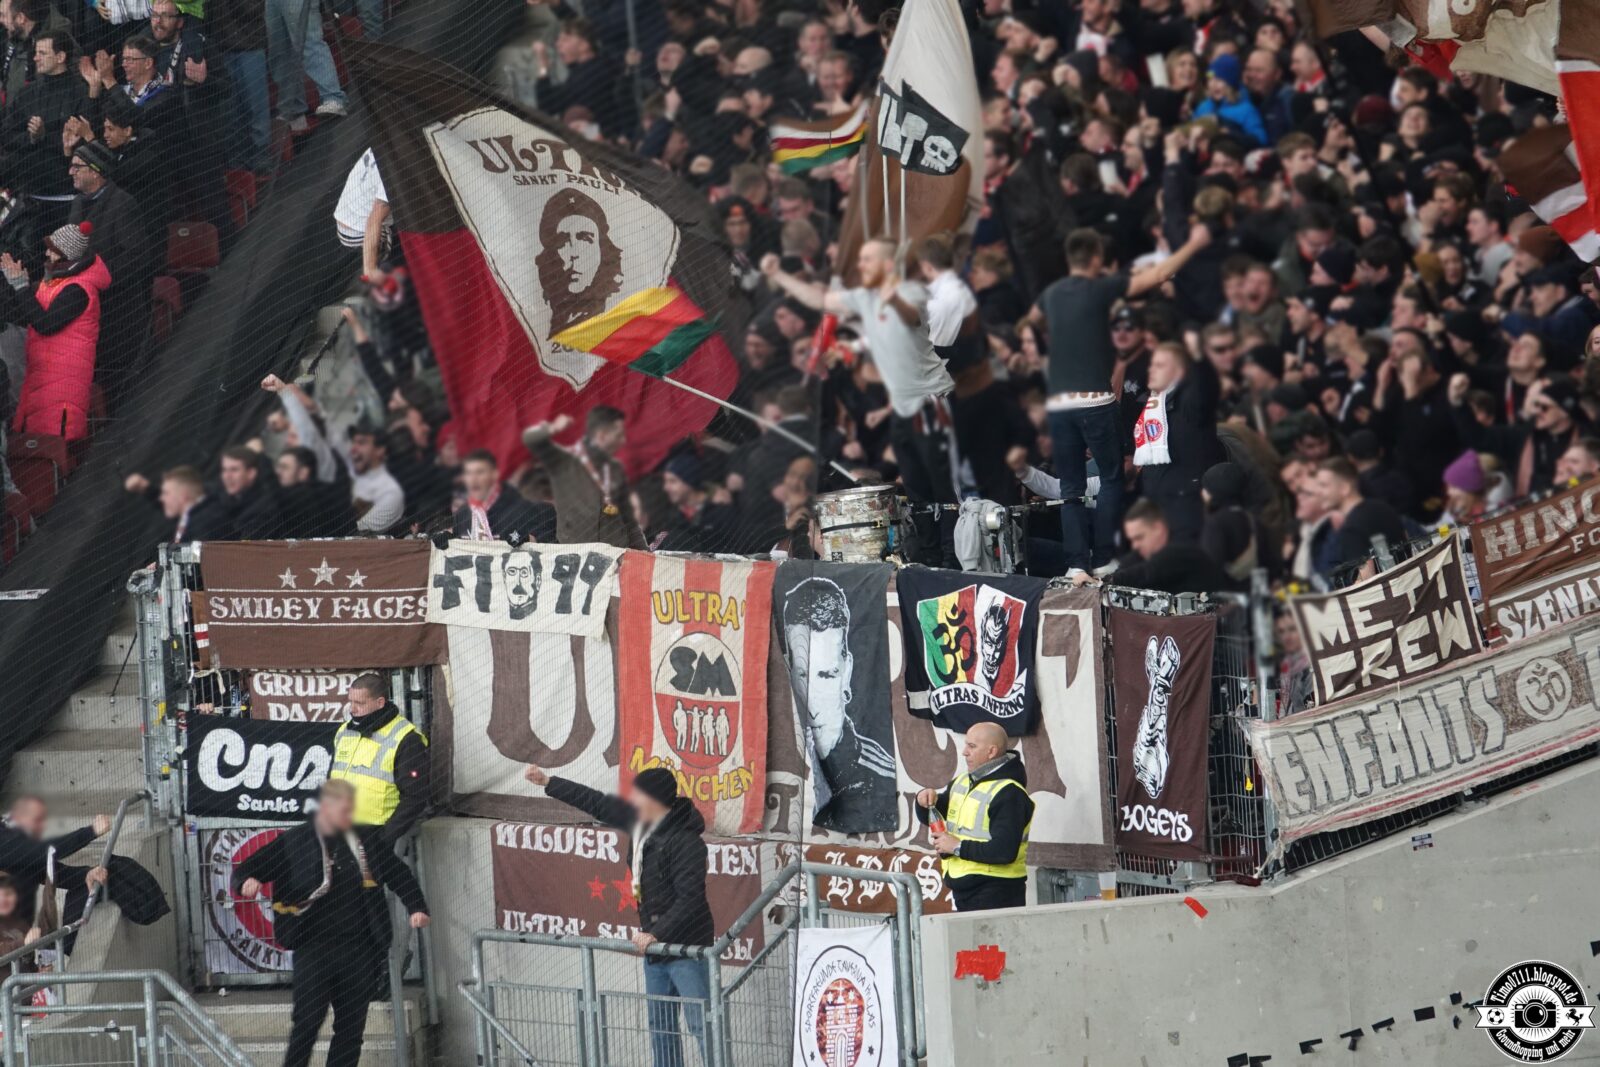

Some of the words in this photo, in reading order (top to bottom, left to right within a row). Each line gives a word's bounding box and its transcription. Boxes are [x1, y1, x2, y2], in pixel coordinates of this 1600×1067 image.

[513, 173, 558, 187] SANKT
[565, 173, 621, 196] PAULI
[209, 596, 319, 620] SMILEY
[331, 597, 430, 619] FACES
[1302, 544, 1454, 652] METT
[1497, 574, 1600, 645] SZENA
[1316, 600, 1475, 701] CREW
[982, 691, 1026, 716] INFERNO
[1262, 664, 1507, 820] ENFANTS
[236, 793, 300, 813] Sankt
[495, 822, 620, 864] WILDER
